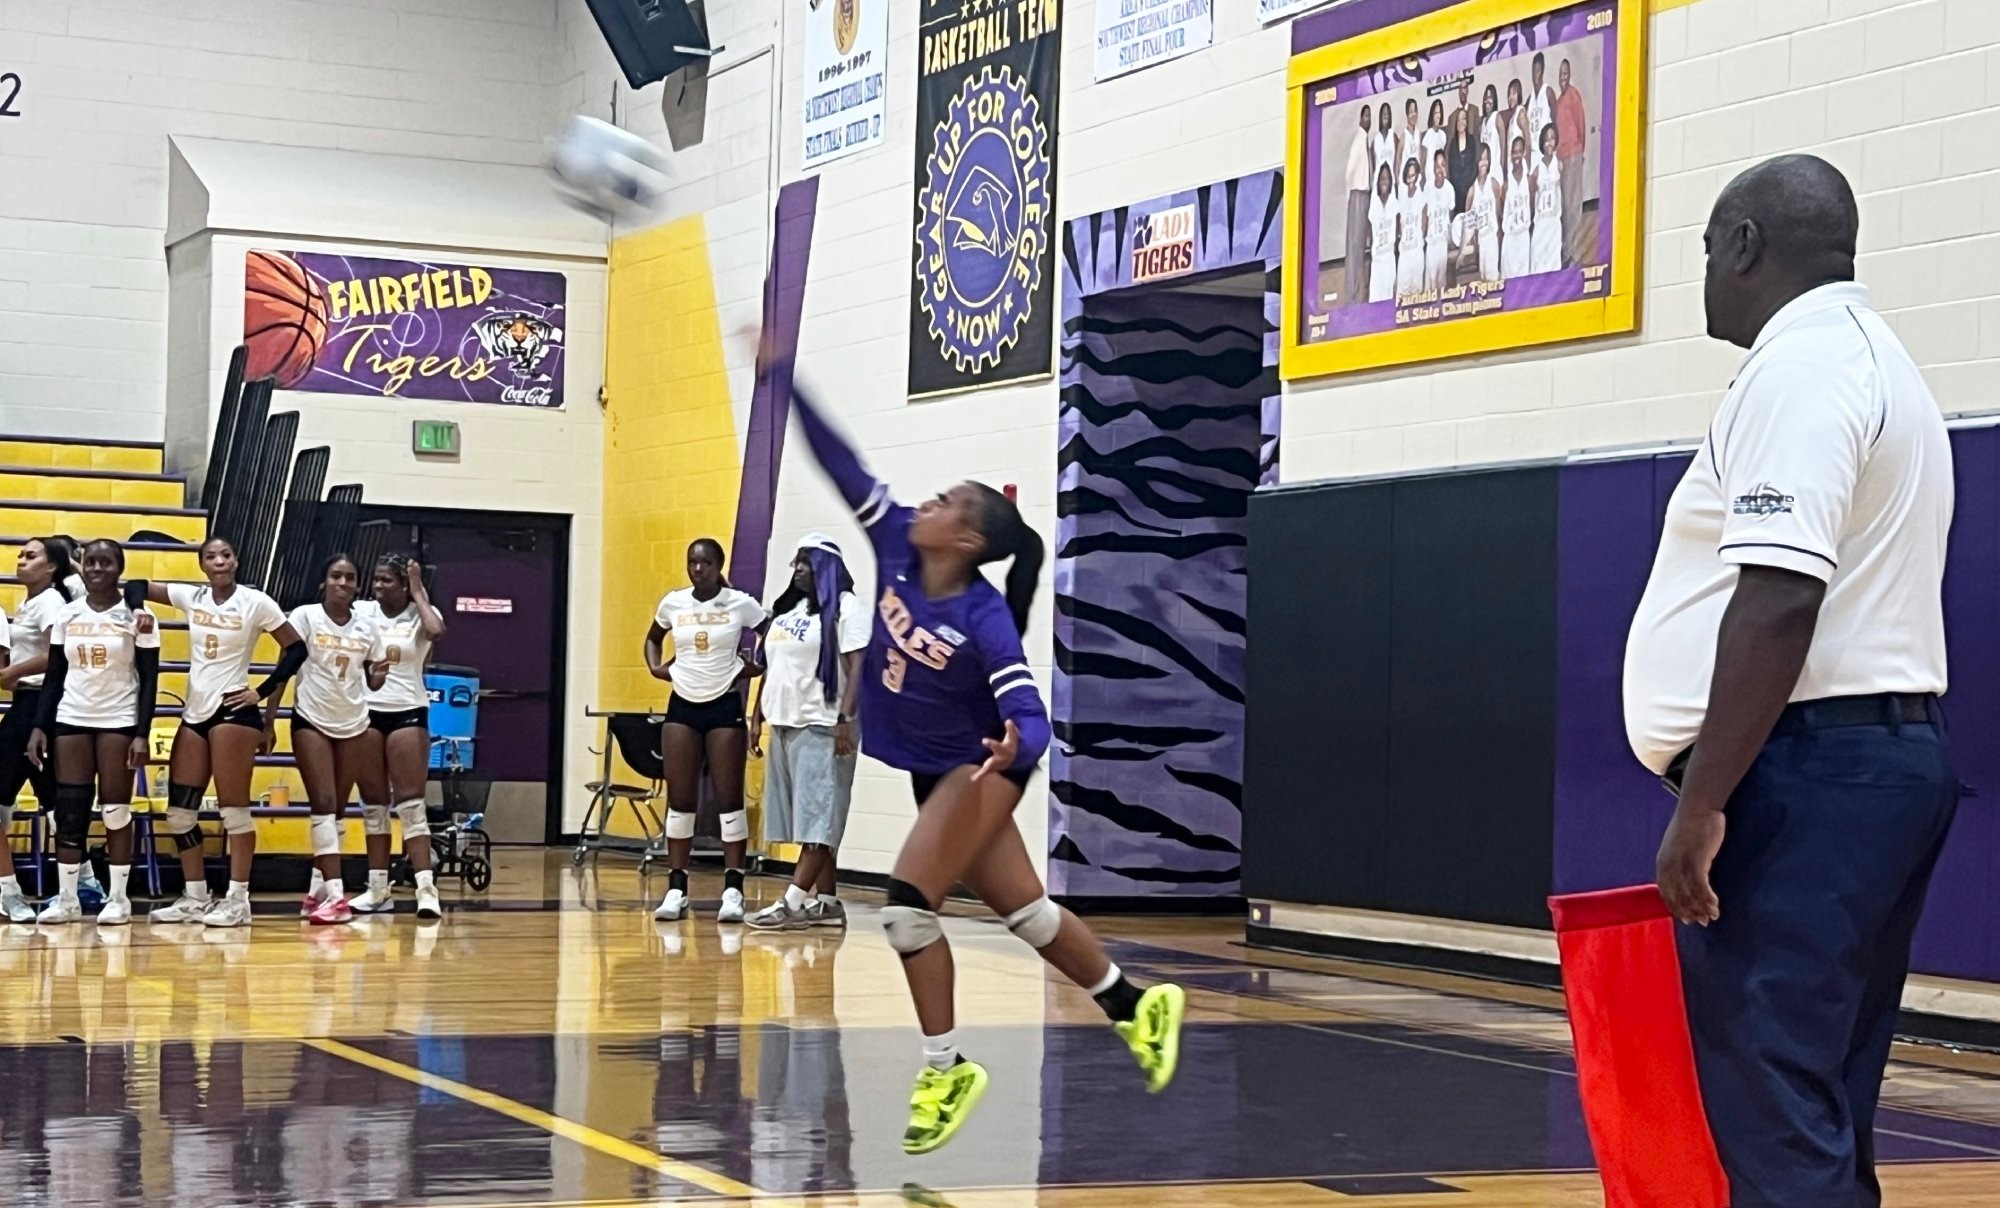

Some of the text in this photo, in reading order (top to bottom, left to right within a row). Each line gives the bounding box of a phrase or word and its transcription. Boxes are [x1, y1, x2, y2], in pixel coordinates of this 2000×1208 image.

[1587, 10, 1612, 31] 2010
[924, 7, 1011, 77] BASKETBALL
[929, 91, 1041, 301] GEAR UP FOR COLLEGE
[1153, 210, 1191, 241] LADY
[1133, 241, 1193, 279] TIGERS
[328, 268, 493, 318] FAIRFIELD
[1412, 306, 1440, 320] State
[1442, 297, 1502, 315] Champions
[1441, 283, 1467, 300] Lady
[1469, 280, 1505, 300] Tigers
[957, 302, 1001, 347] NOW
[341, 324, 496, 396] Tigers
[421, 425, 454, 449] EXIT
[335, 653, 350, 682] 7
[882, 647, 907, 693] 3
